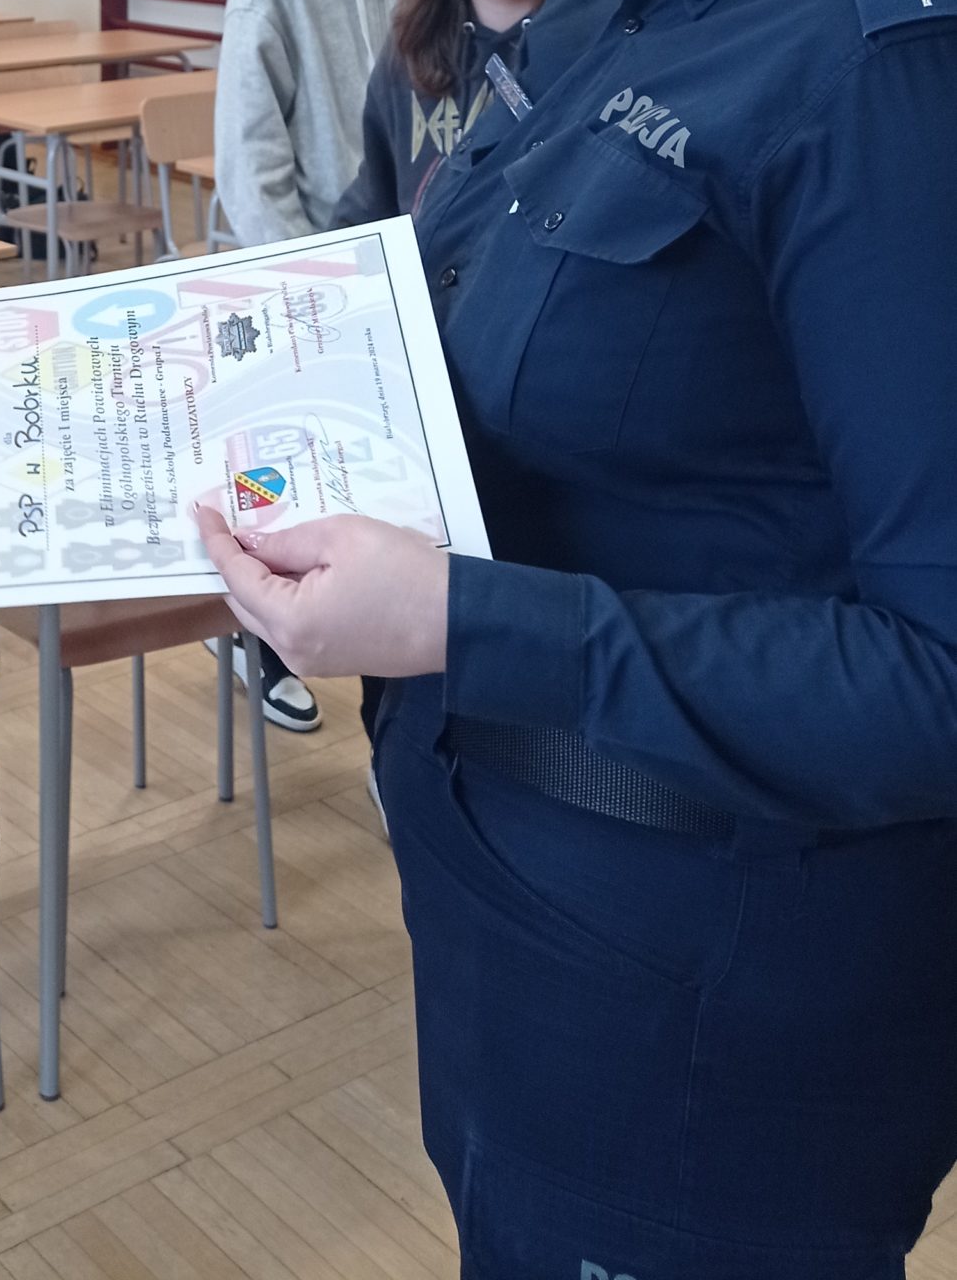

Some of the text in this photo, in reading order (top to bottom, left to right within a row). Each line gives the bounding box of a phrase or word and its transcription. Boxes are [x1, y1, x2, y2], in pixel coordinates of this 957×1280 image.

[154, 351, 165, 381] Grupa
[12, 356, 42, 448] Bobrku
[56, 377, 73, 421] miejsca
[157, 388, 173, 449] Podstawowe
[183, 376, 203, 465] ORGANIZATORZY
[4, 432, 13, 445] dla
[86, 336, 116, 527] w Eliminacjach Powiatowych
[108, 344, 138, 510] Ogólnopolskiego Turnieju
[126, 309, 161, 545] Bezpieczeństwa w Ruchu Drogowym
[257, 429, 301, 460] 65
[58, 434, 76, 475] zajęcie
[165, 451, 176, 484] Szkoły
[64, 478, 75, 492] za
[168, 485, 178, 504] kat.
[18, 494, 44, 537] PSP
